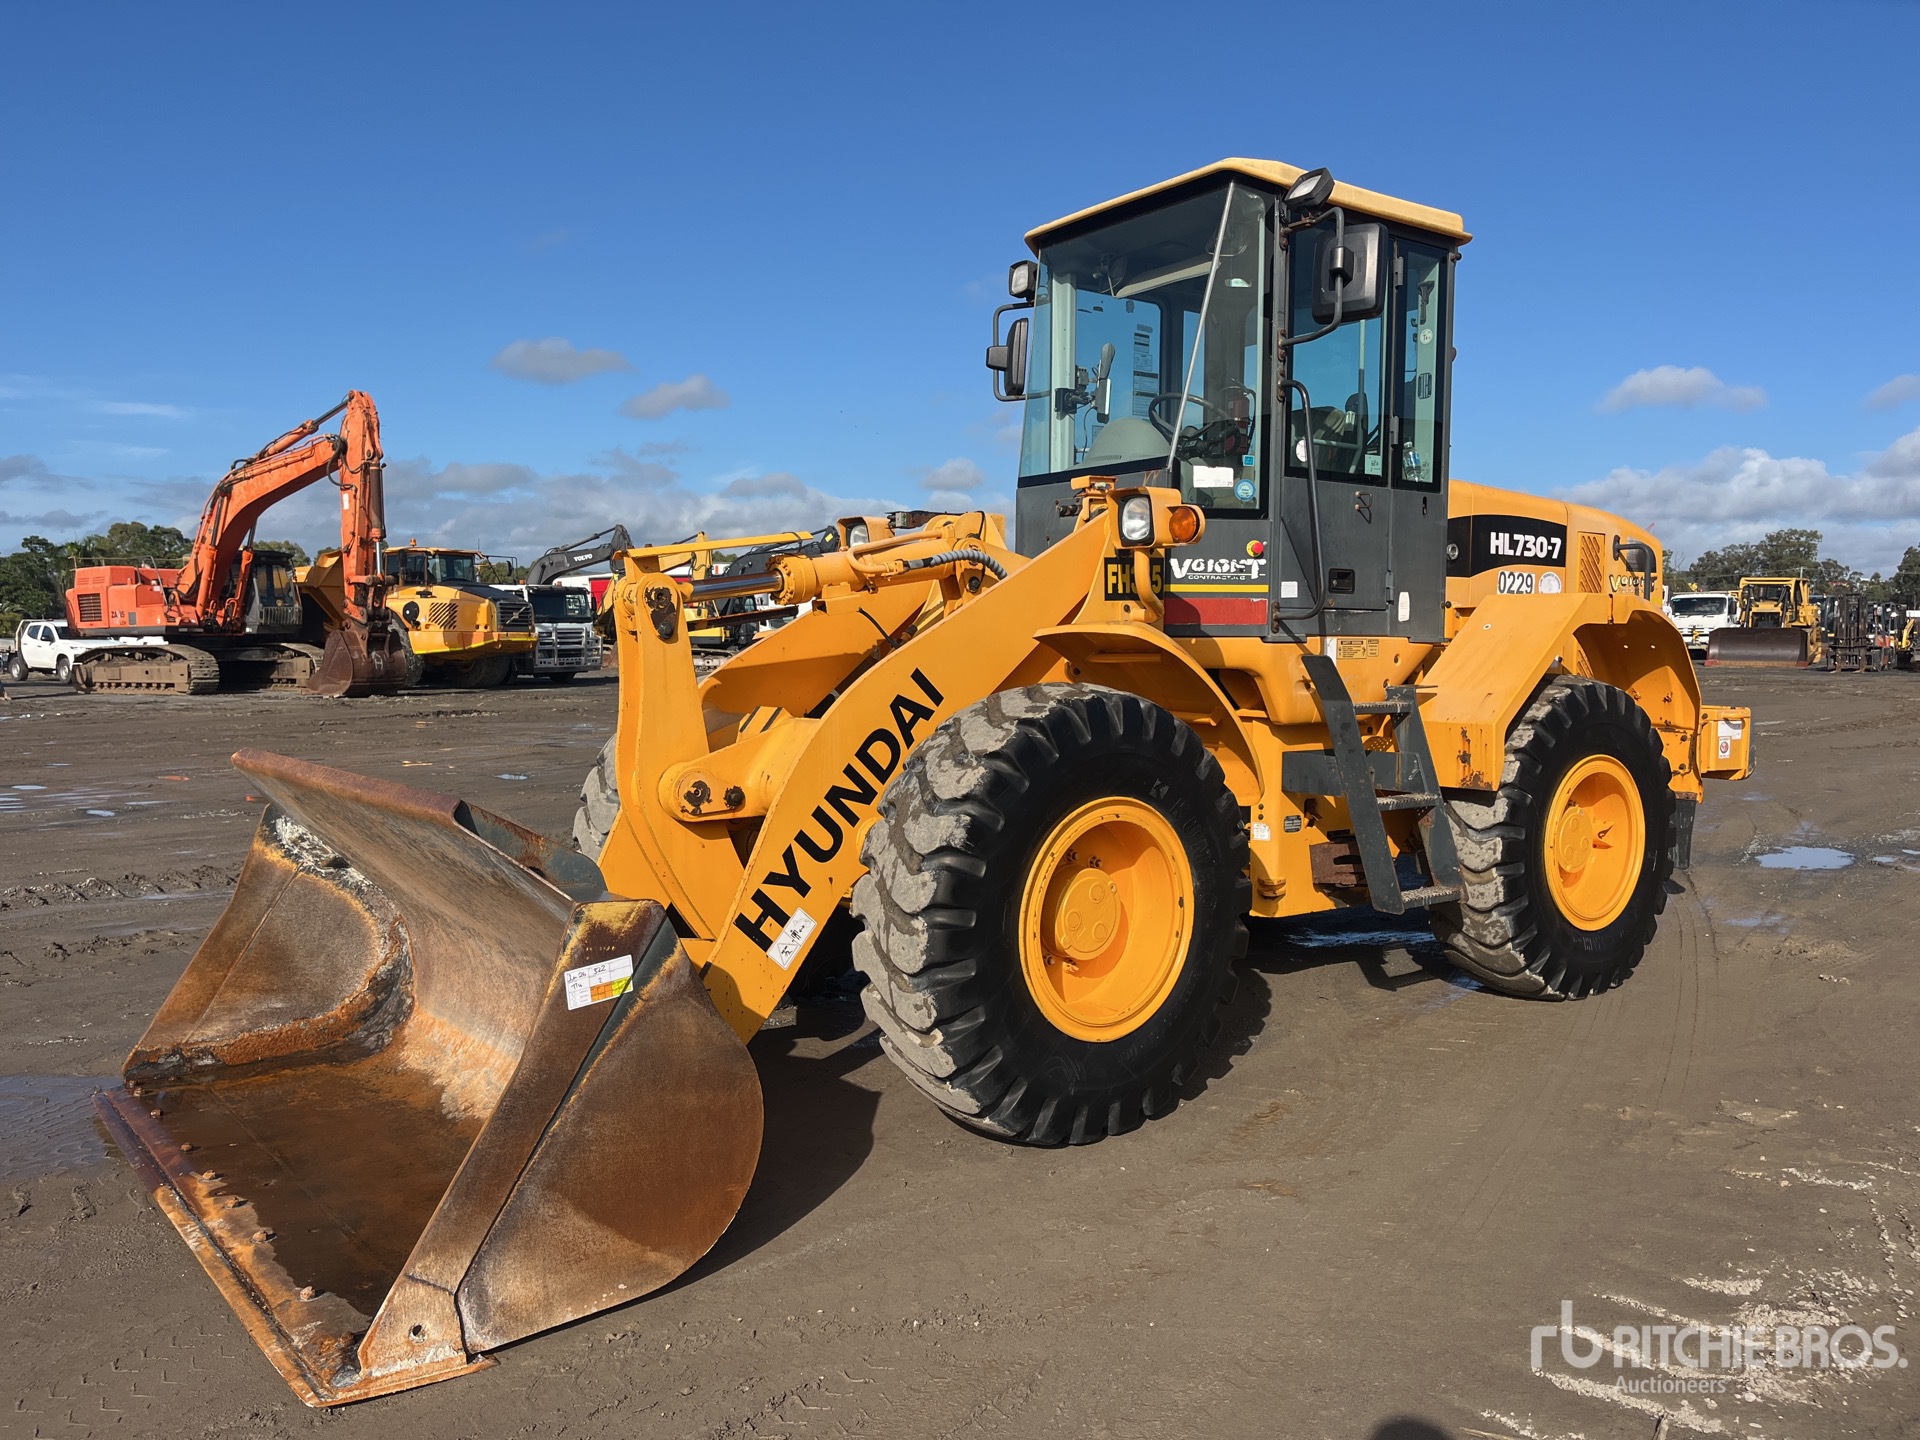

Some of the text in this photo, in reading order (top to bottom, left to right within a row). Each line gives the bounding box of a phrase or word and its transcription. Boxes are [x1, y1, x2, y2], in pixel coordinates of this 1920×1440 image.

[1490, 532, 1562, 560] HL730-7
[1107, 563, 1162, 594] FH5
[1498, 571, 1533, 595] 0229
[733, 667, 945, 954] HYUNDAI
